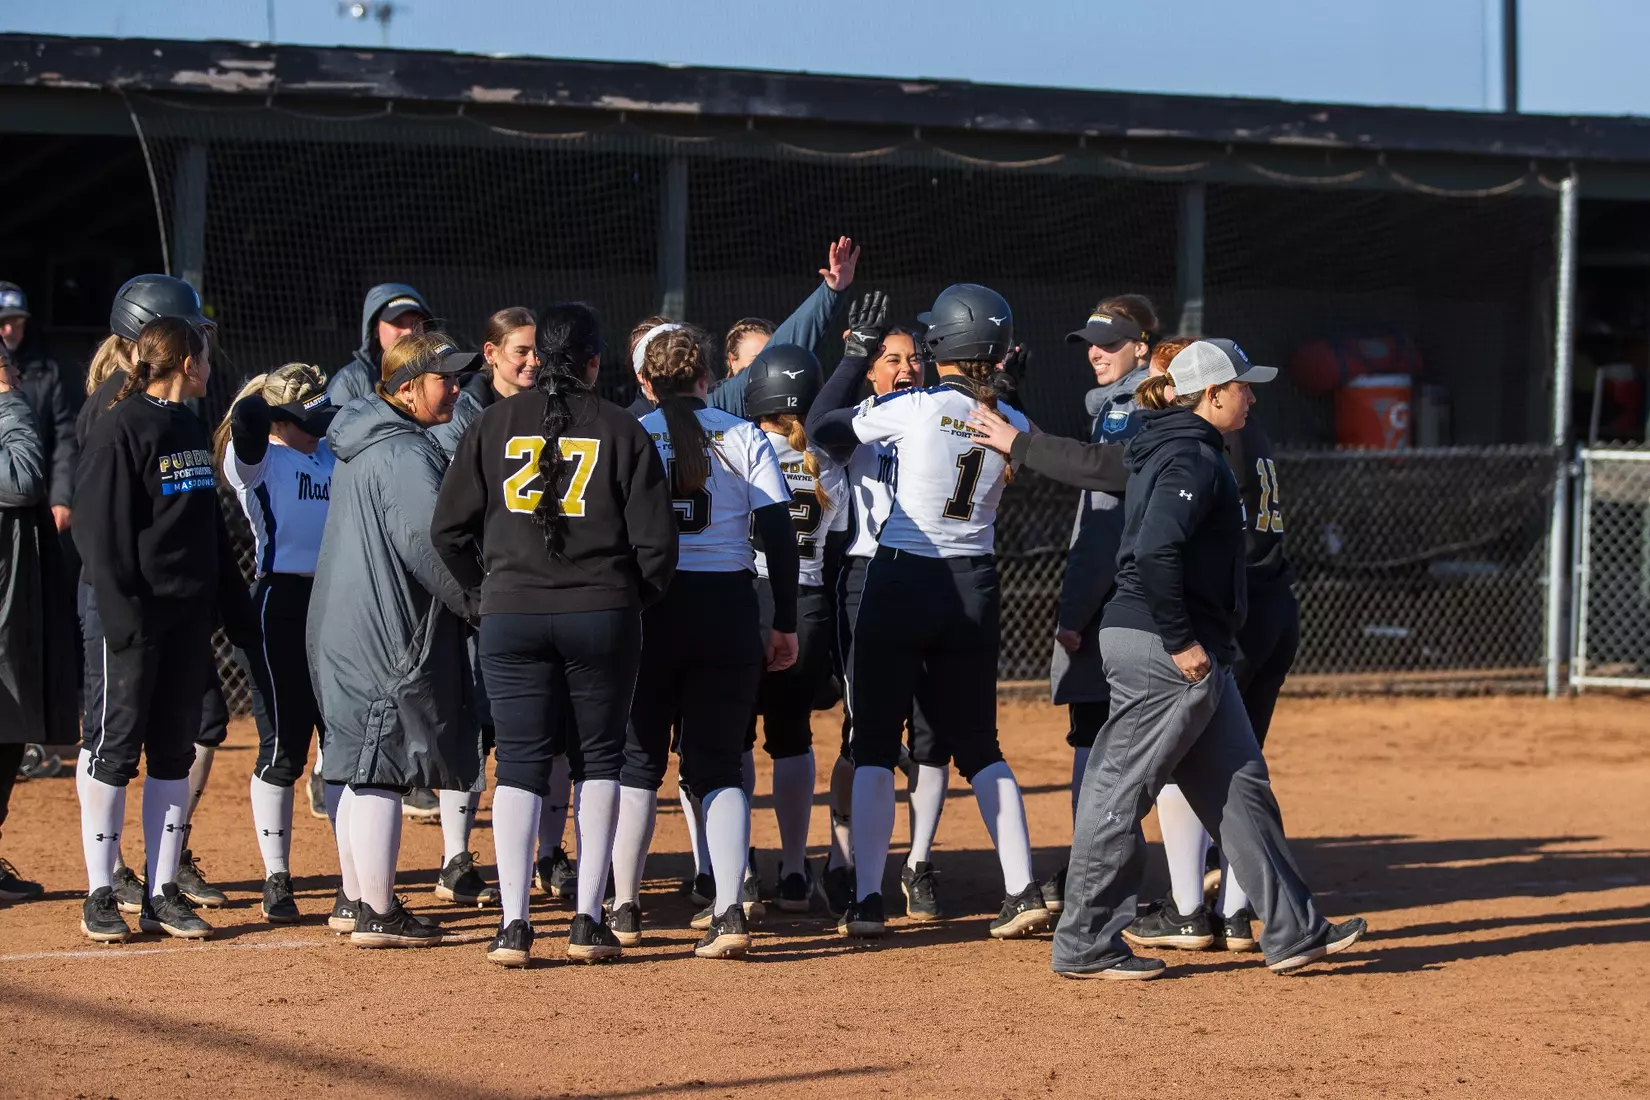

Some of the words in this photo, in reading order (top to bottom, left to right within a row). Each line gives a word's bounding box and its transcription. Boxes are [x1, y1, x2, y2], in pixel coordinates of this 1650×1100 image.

[787, 397, 798, 407] 12
[503, 435, 601, 517] 27
[786, 473, 813, 482] WAYNE
[942, 446, 986, 522] 1
